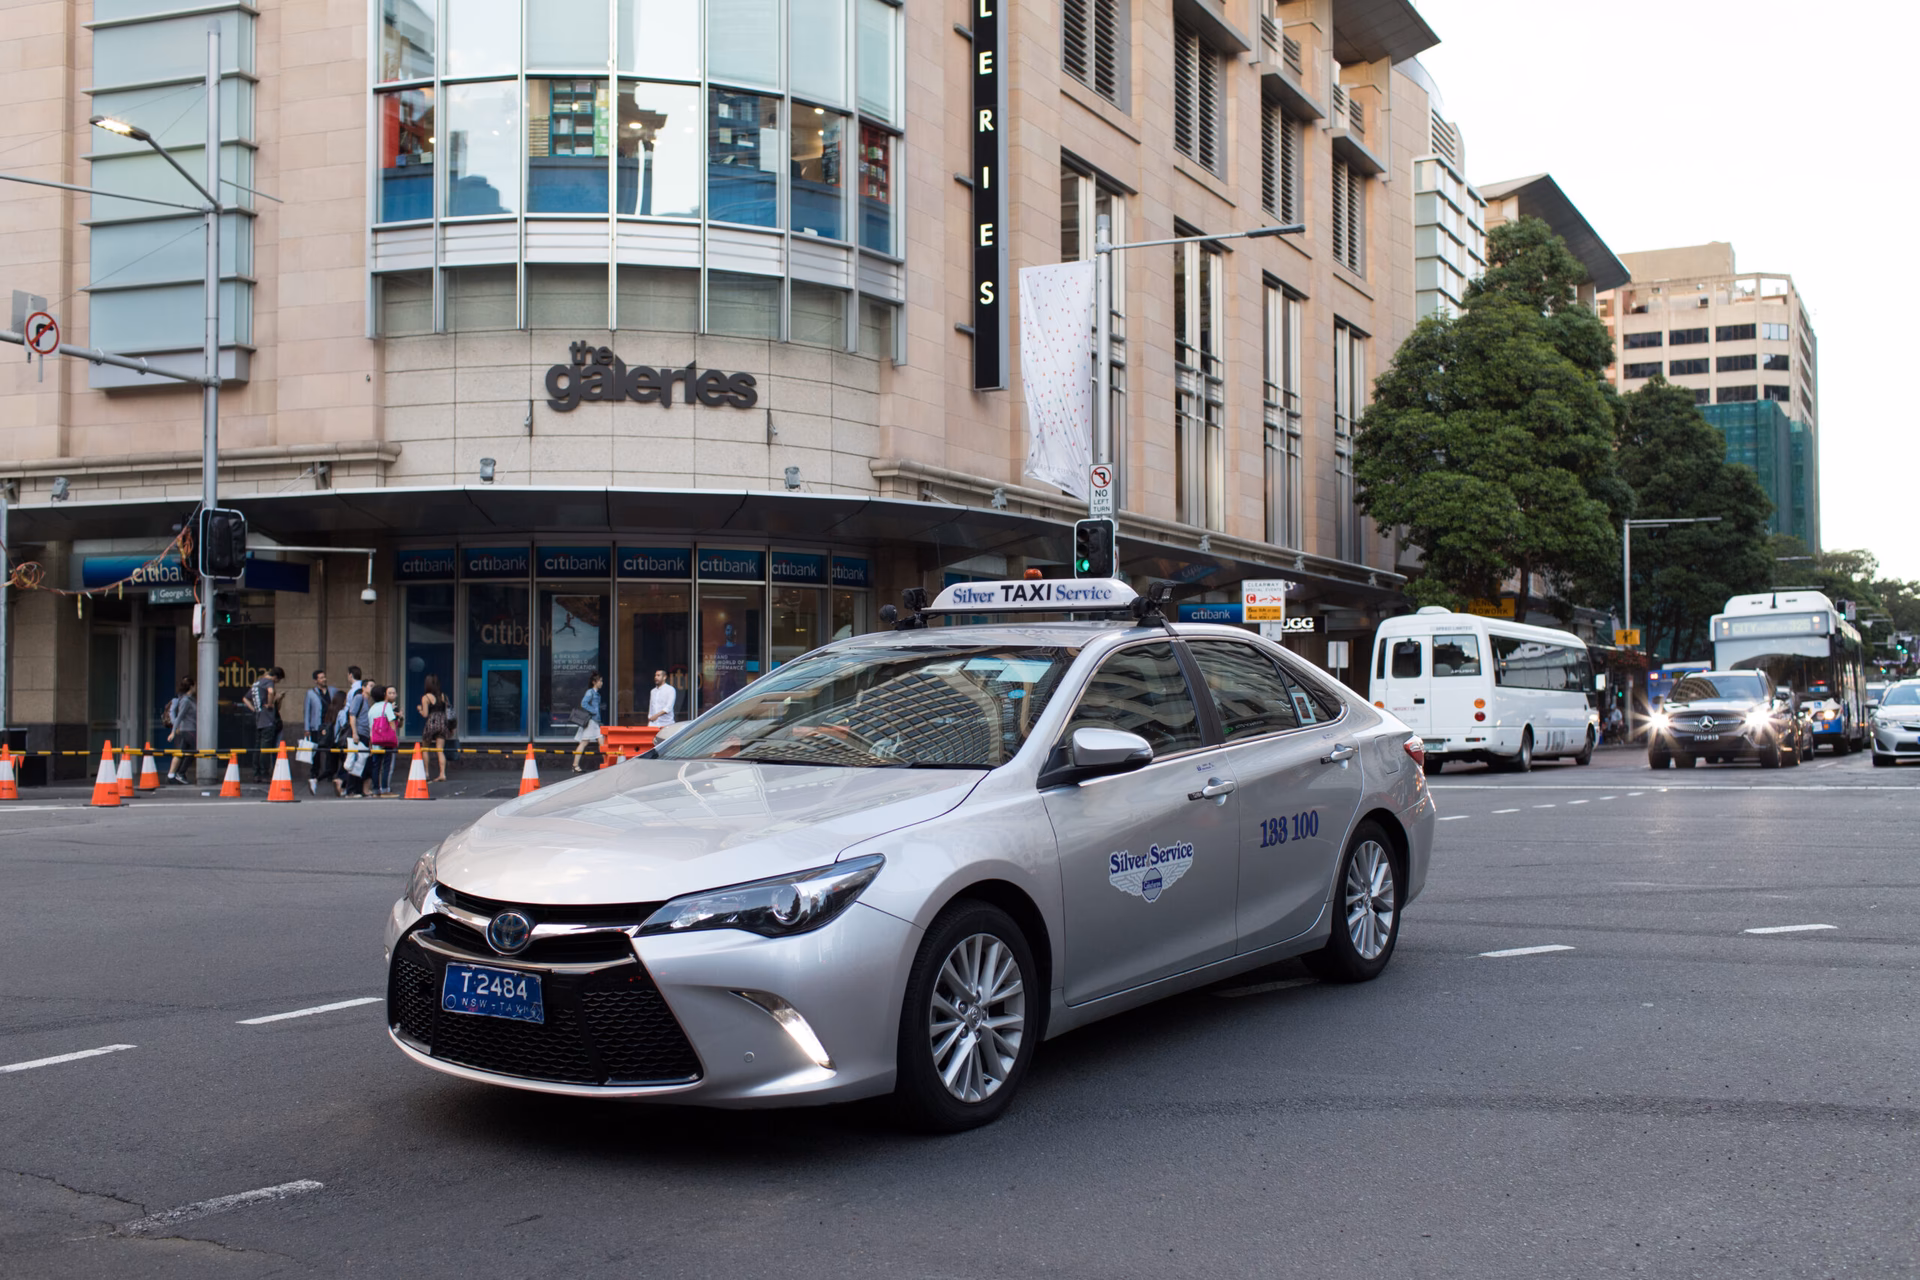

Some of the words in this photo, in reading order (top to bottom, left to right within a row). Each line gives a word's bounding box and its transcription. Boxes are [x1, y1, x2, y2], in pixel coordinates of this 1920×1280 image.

[979, 0, 995, 305] LERIES
[569, 340, 614, 366] the
[545, 354, 758, 412] galeries
[1095, 489, 1108, 498] NO
[402, 557, 455, 574] citibank
[469, 555, 527, 571] citibank
[544, 554, 607, 571] citibank
[623, 555, 685, 571] citibank
[700, 557, 757, 574] citibank
[772, 561, 817, 577] citibank
[159, 589, 184, 599] George
[184, 588, 192, 597] St
[953, 587, 995, 604] Silver
[1000, 583, 1051, 602] TAXI
[1055, 585, 1112, 601] Service
[1191, 610, 1230, 620] citibank
[1732, 623, 1757, 633] CITY
[1260, 815, 1288, 848] 133
[1291, 809, 1319, 841] 100
[1110, 852, 1147, 874] Silver
[1150, 841, 1193, 865] Service
